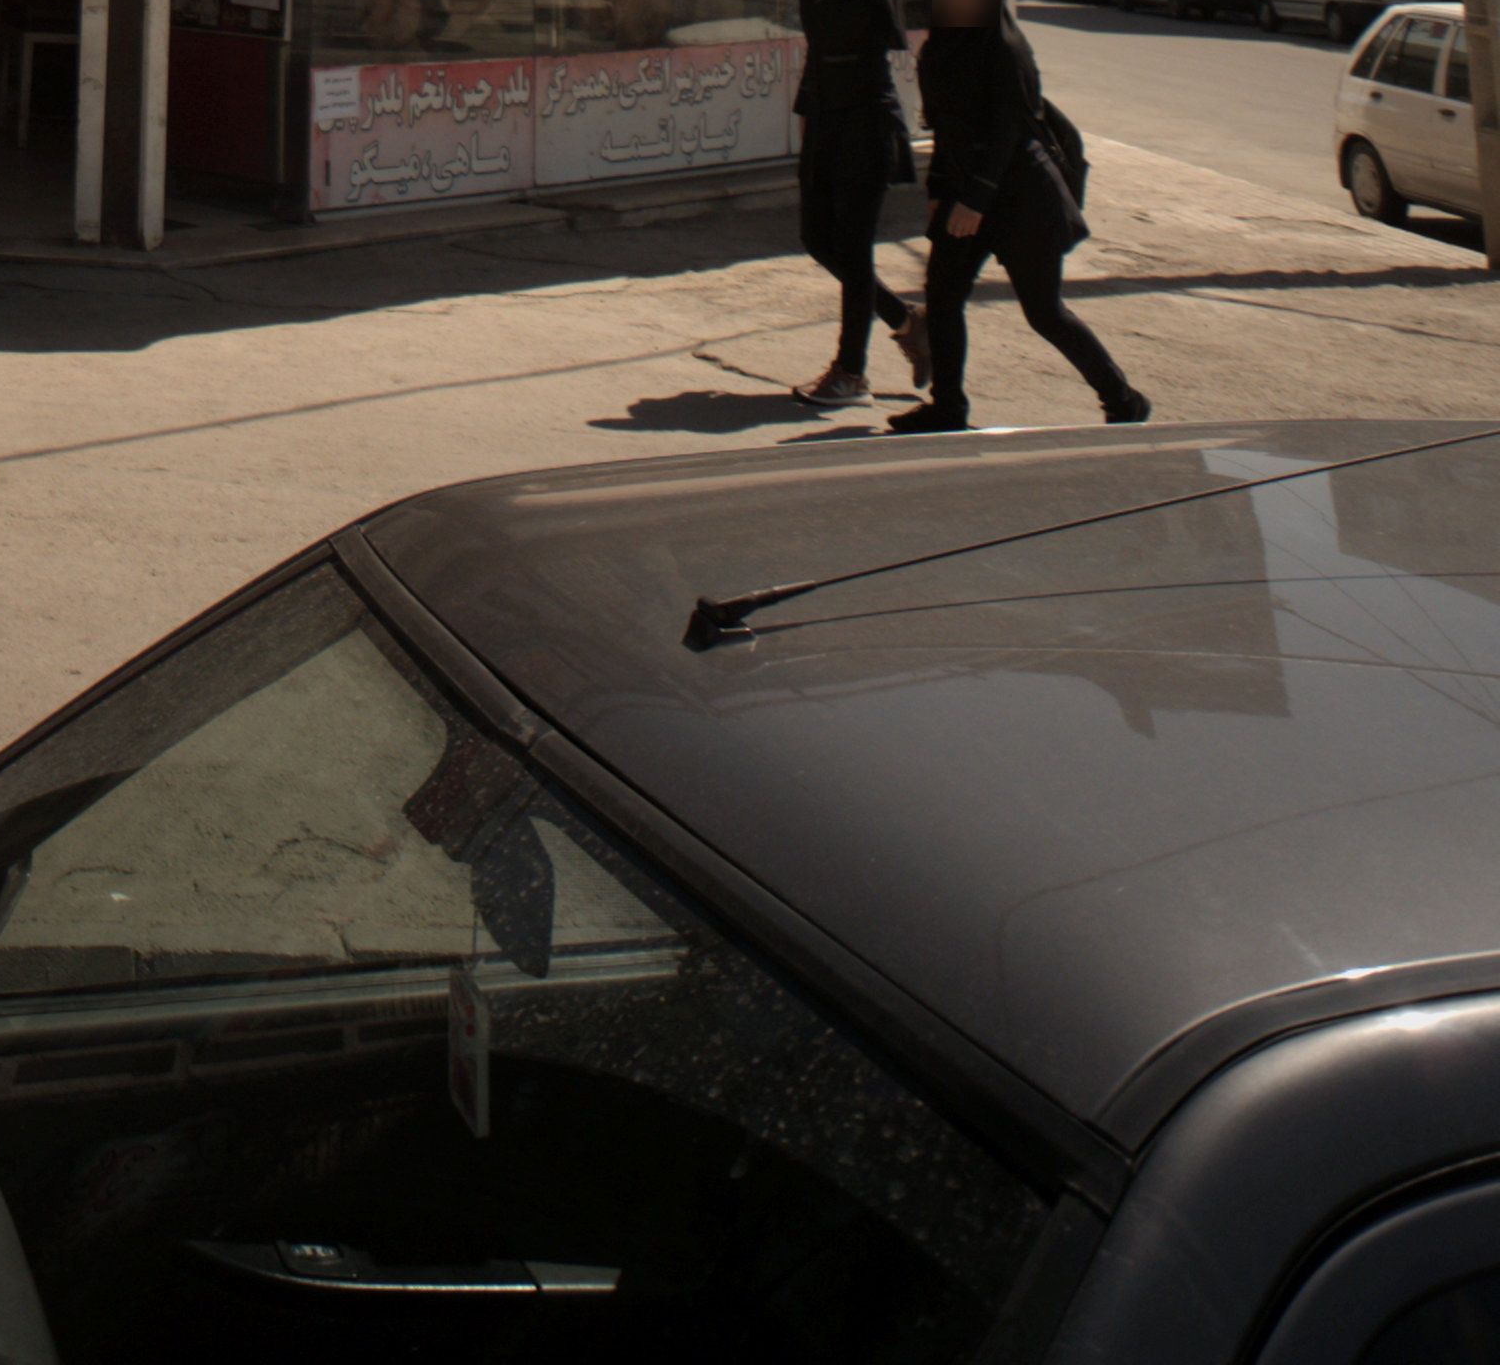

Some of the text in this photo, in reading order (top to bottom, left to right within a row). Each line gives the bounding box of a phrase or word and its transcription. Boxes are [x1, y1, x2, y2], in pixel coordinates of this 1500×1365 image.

[407, 68, 446, 128] تخم
[694, 50, 736, 104] خمیر
[740, 46, 782, 97] انواع
[597, 106, 742, 164] کباب لقمه
[345, 139, 422, 202] میگو
